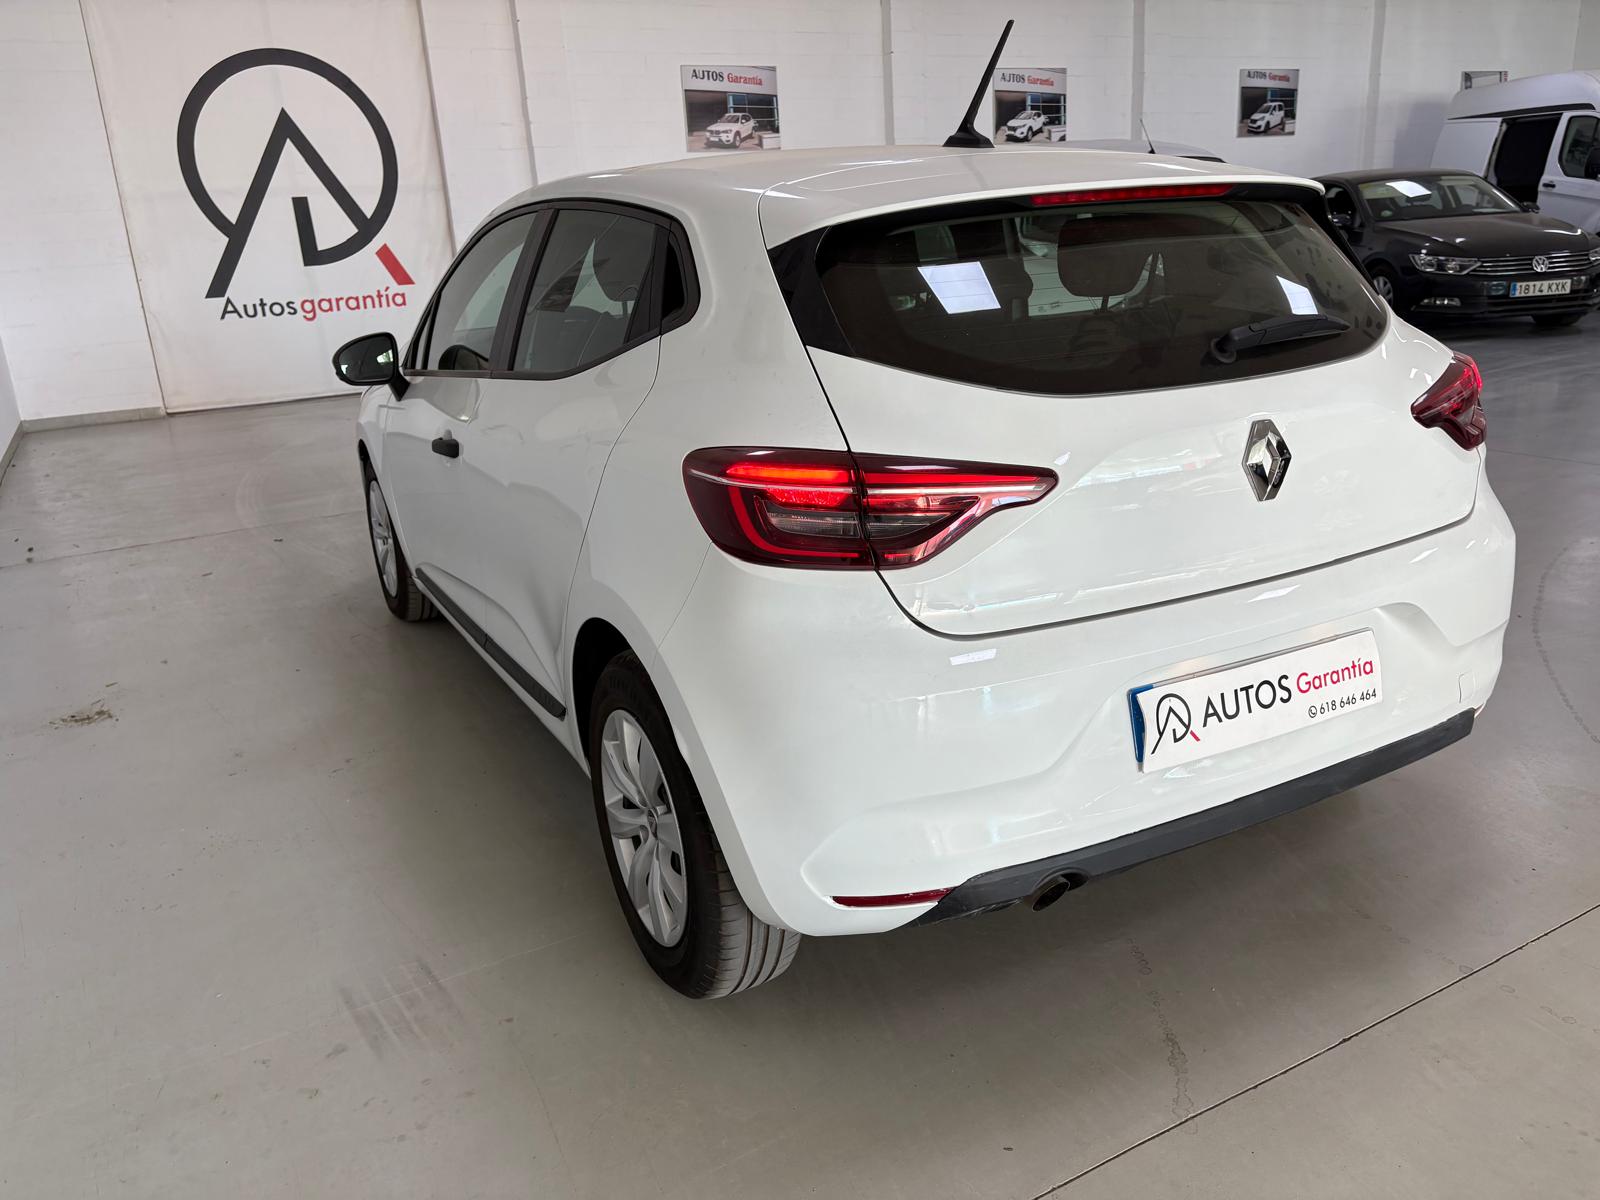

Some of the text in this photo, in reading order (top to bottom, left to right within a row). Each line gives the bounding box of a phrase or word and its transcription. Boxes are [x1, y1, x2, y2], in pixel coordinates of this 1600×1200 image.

[691, 69, 763, 86] AUTOS Garantía
[1000, 73, 1026, 83] AUTOS
[1519, 281, 1568, 295] 1814 KXK
[1202, 658, 1374, 728] AUTOS Garantía
[1319, 687, 1377, 715] 618 646 464
